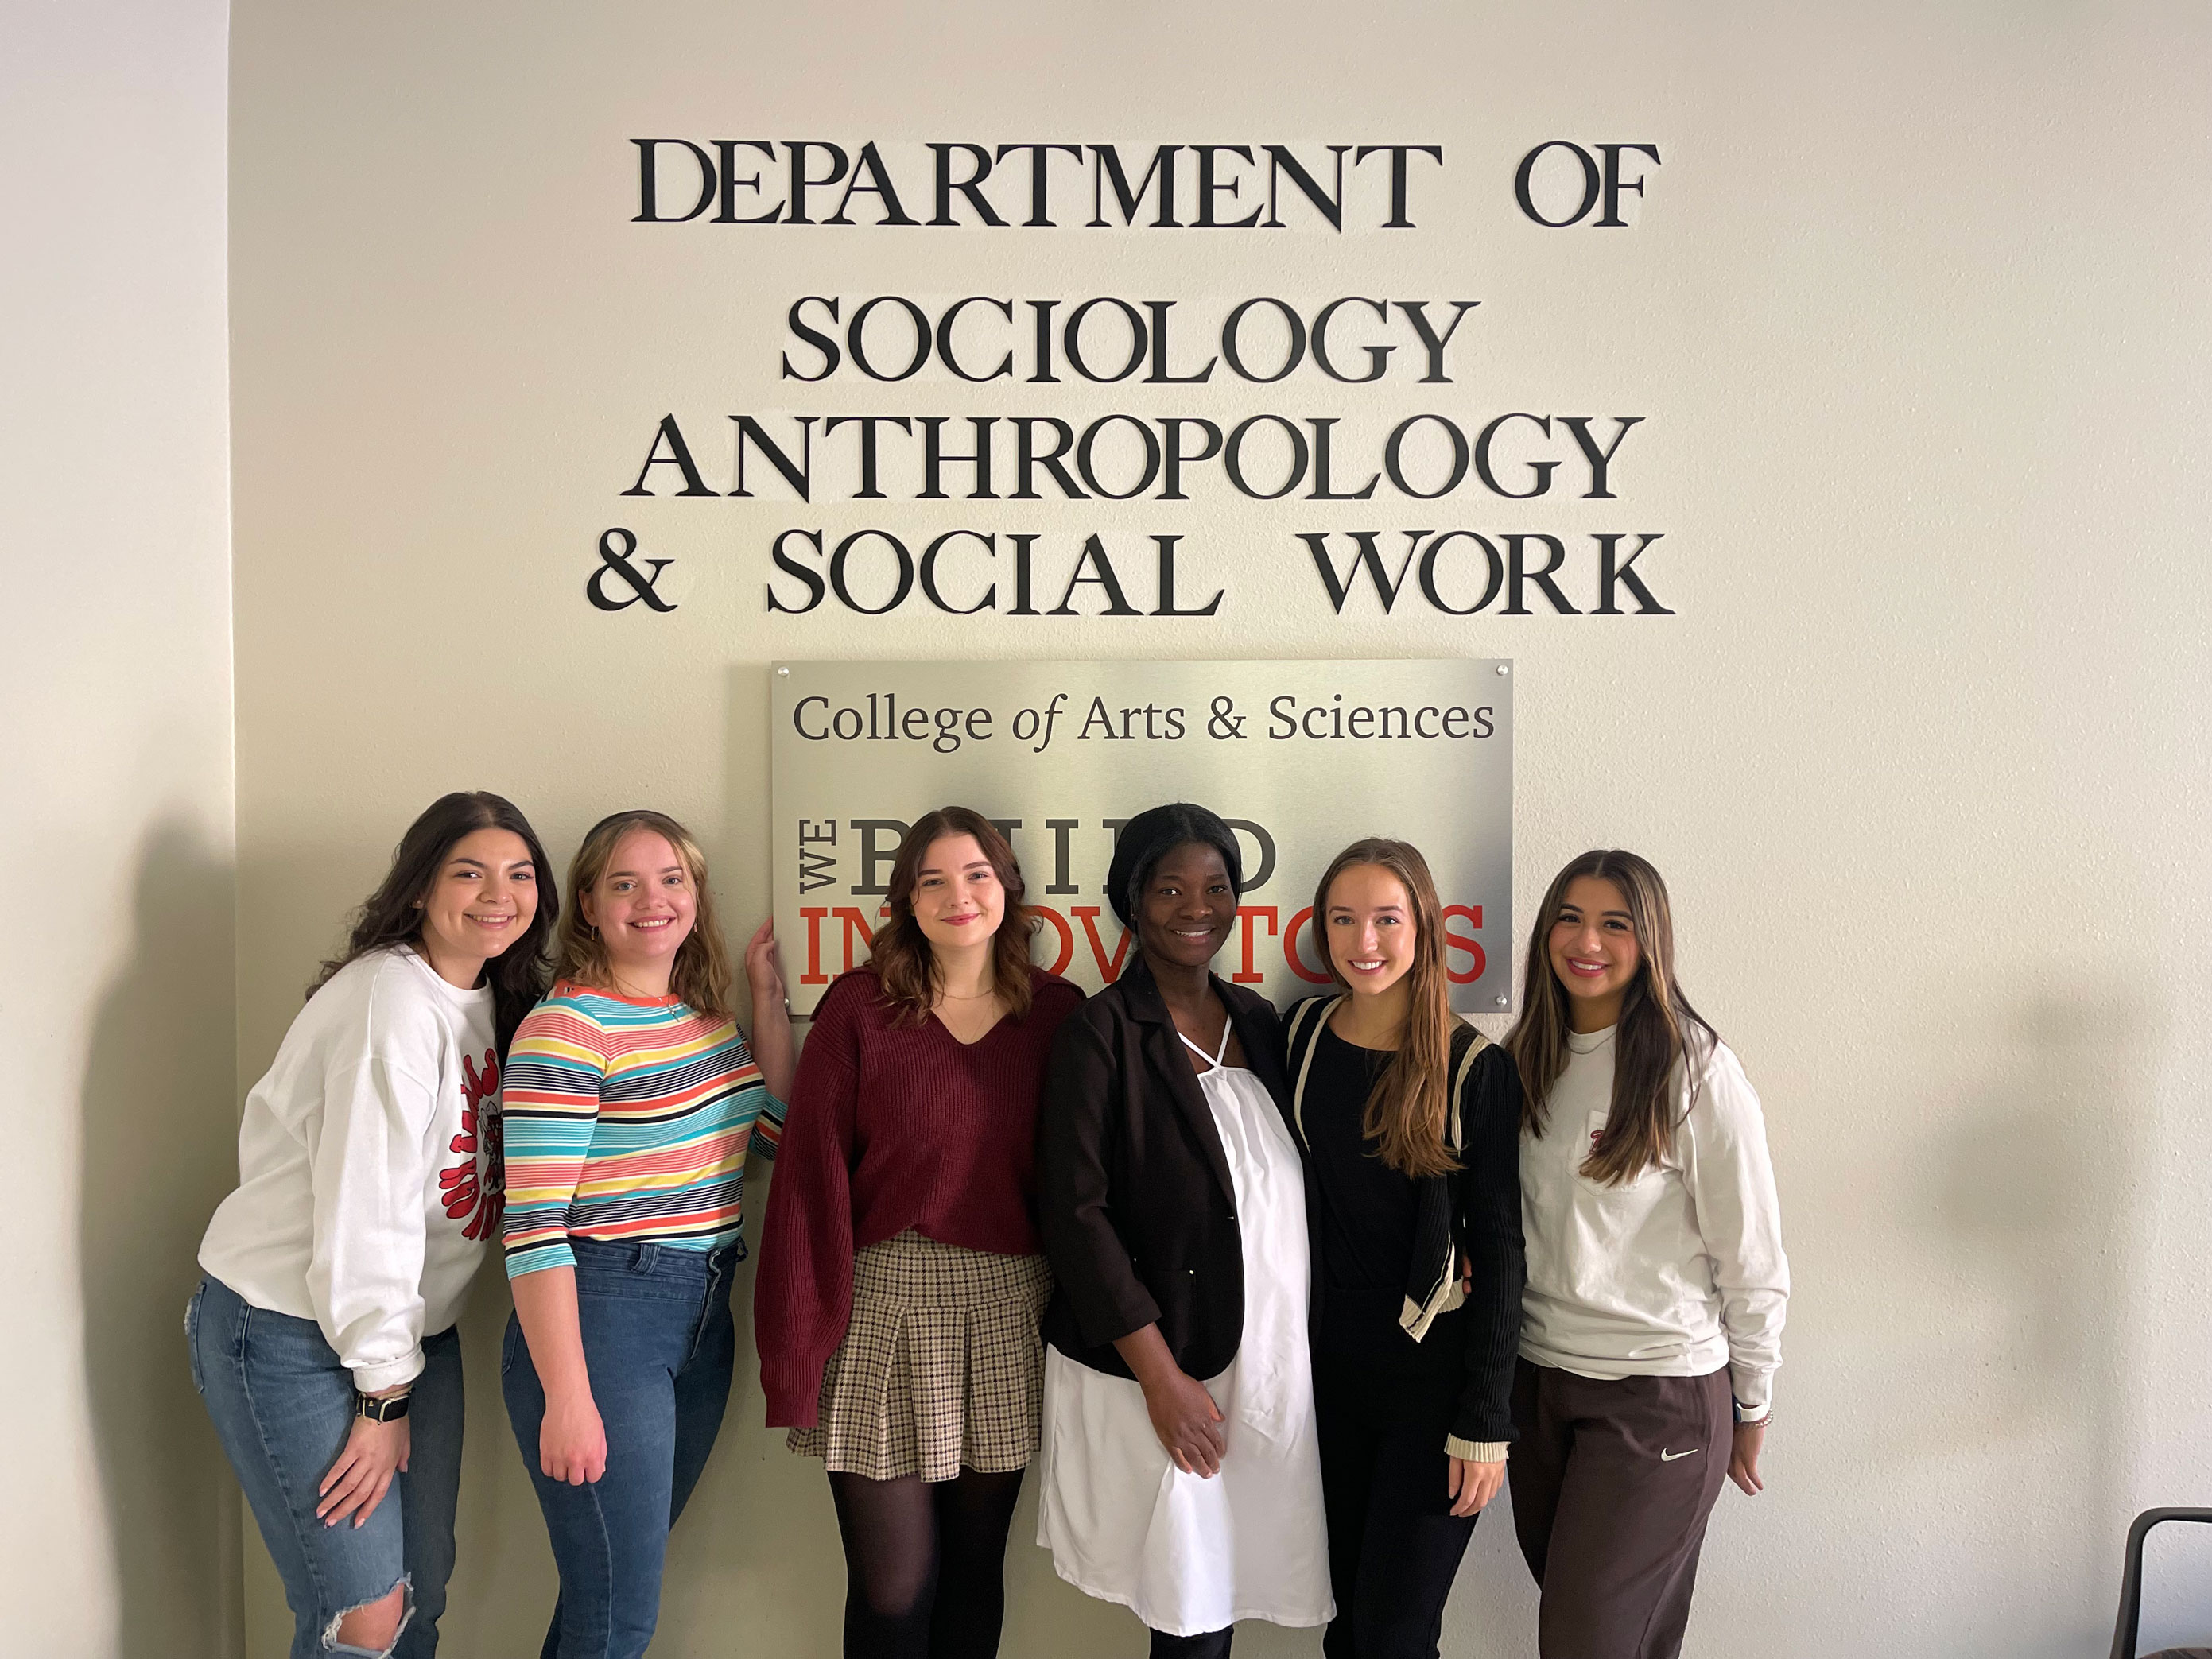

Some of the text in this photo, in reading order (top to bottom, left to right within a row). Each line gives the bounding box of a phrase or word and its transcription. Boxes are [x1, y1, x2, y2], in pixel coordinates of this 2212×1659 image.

[629, 138, 1661, 234] DEPARTMENT OF
[782, 296, 1481, 383] SOCIOLOGY
[620, 413, 1646, 504] ANTHROPOLOGY
[586, 527, 1676, 616] & SOCIAL WORK
[794, 692, 1494, 754] College of Arts & Sciences
[799, 819, 837, 895] WE
